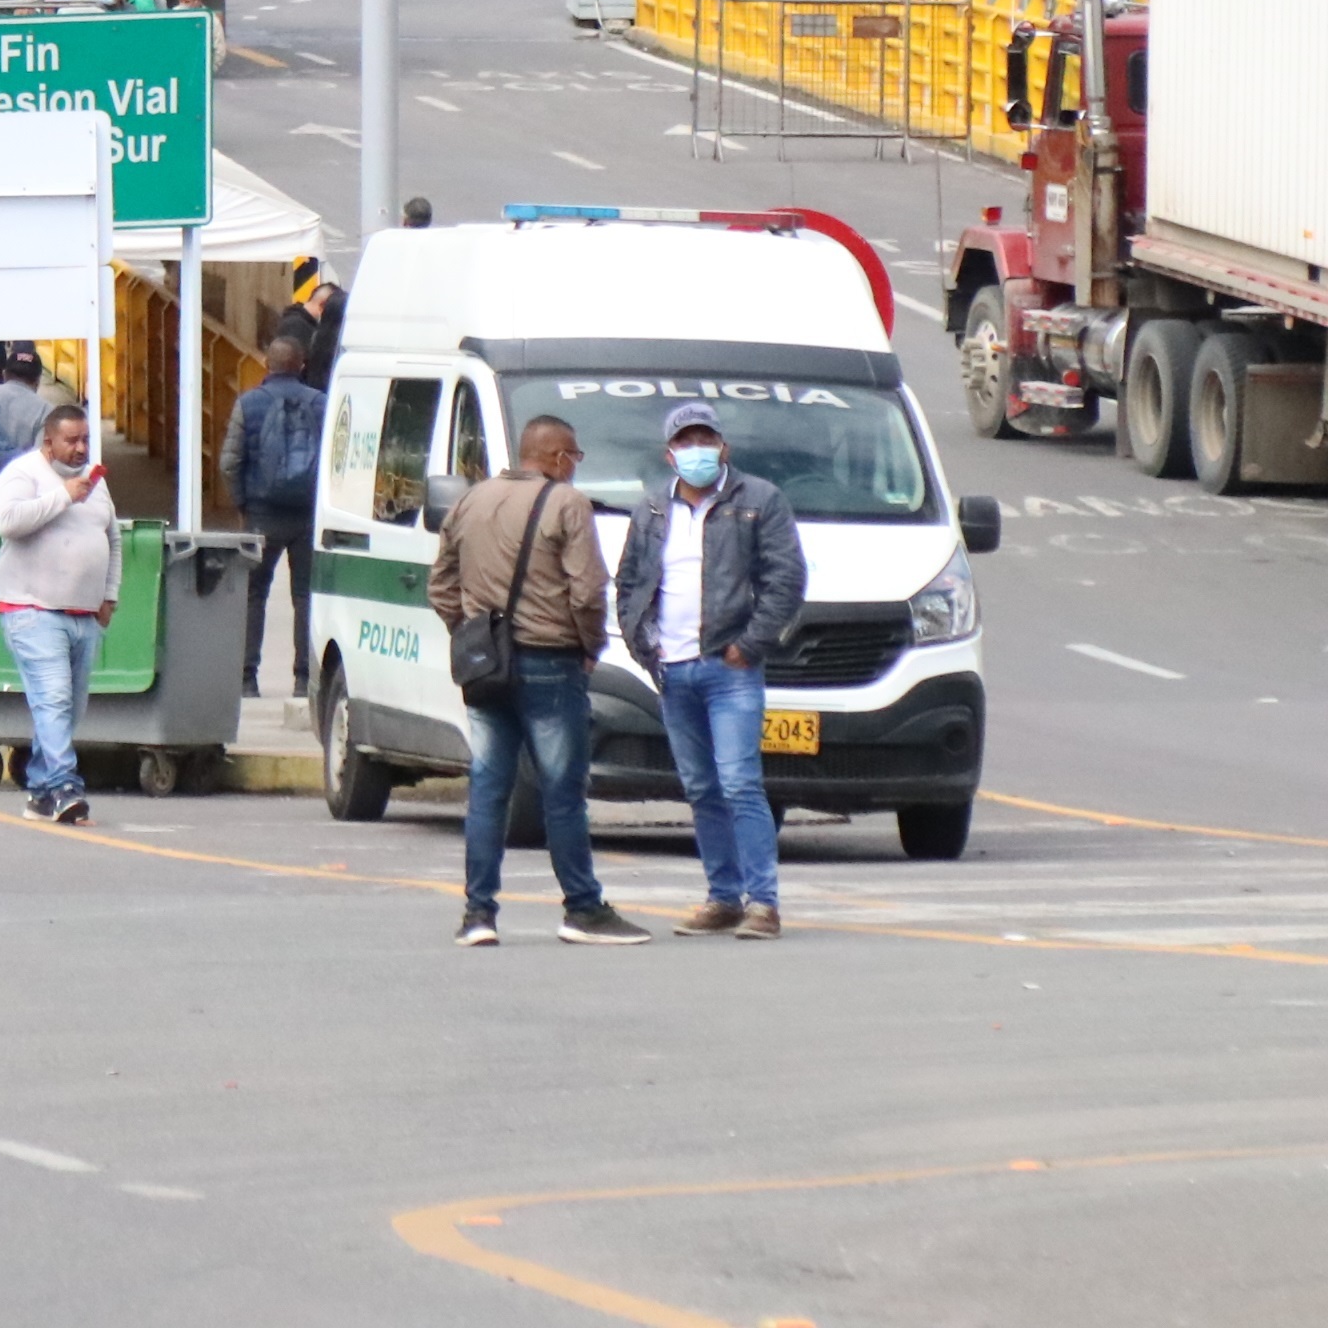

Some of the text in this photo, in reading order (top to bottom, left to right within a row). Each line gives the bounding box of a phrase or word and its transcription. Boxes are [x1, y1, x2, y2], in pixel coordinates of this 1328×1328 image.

[0, 33, 61, 73] Fin
[108, 76, 179, 117] Vial
[109, 125, 167, 164] Sur
